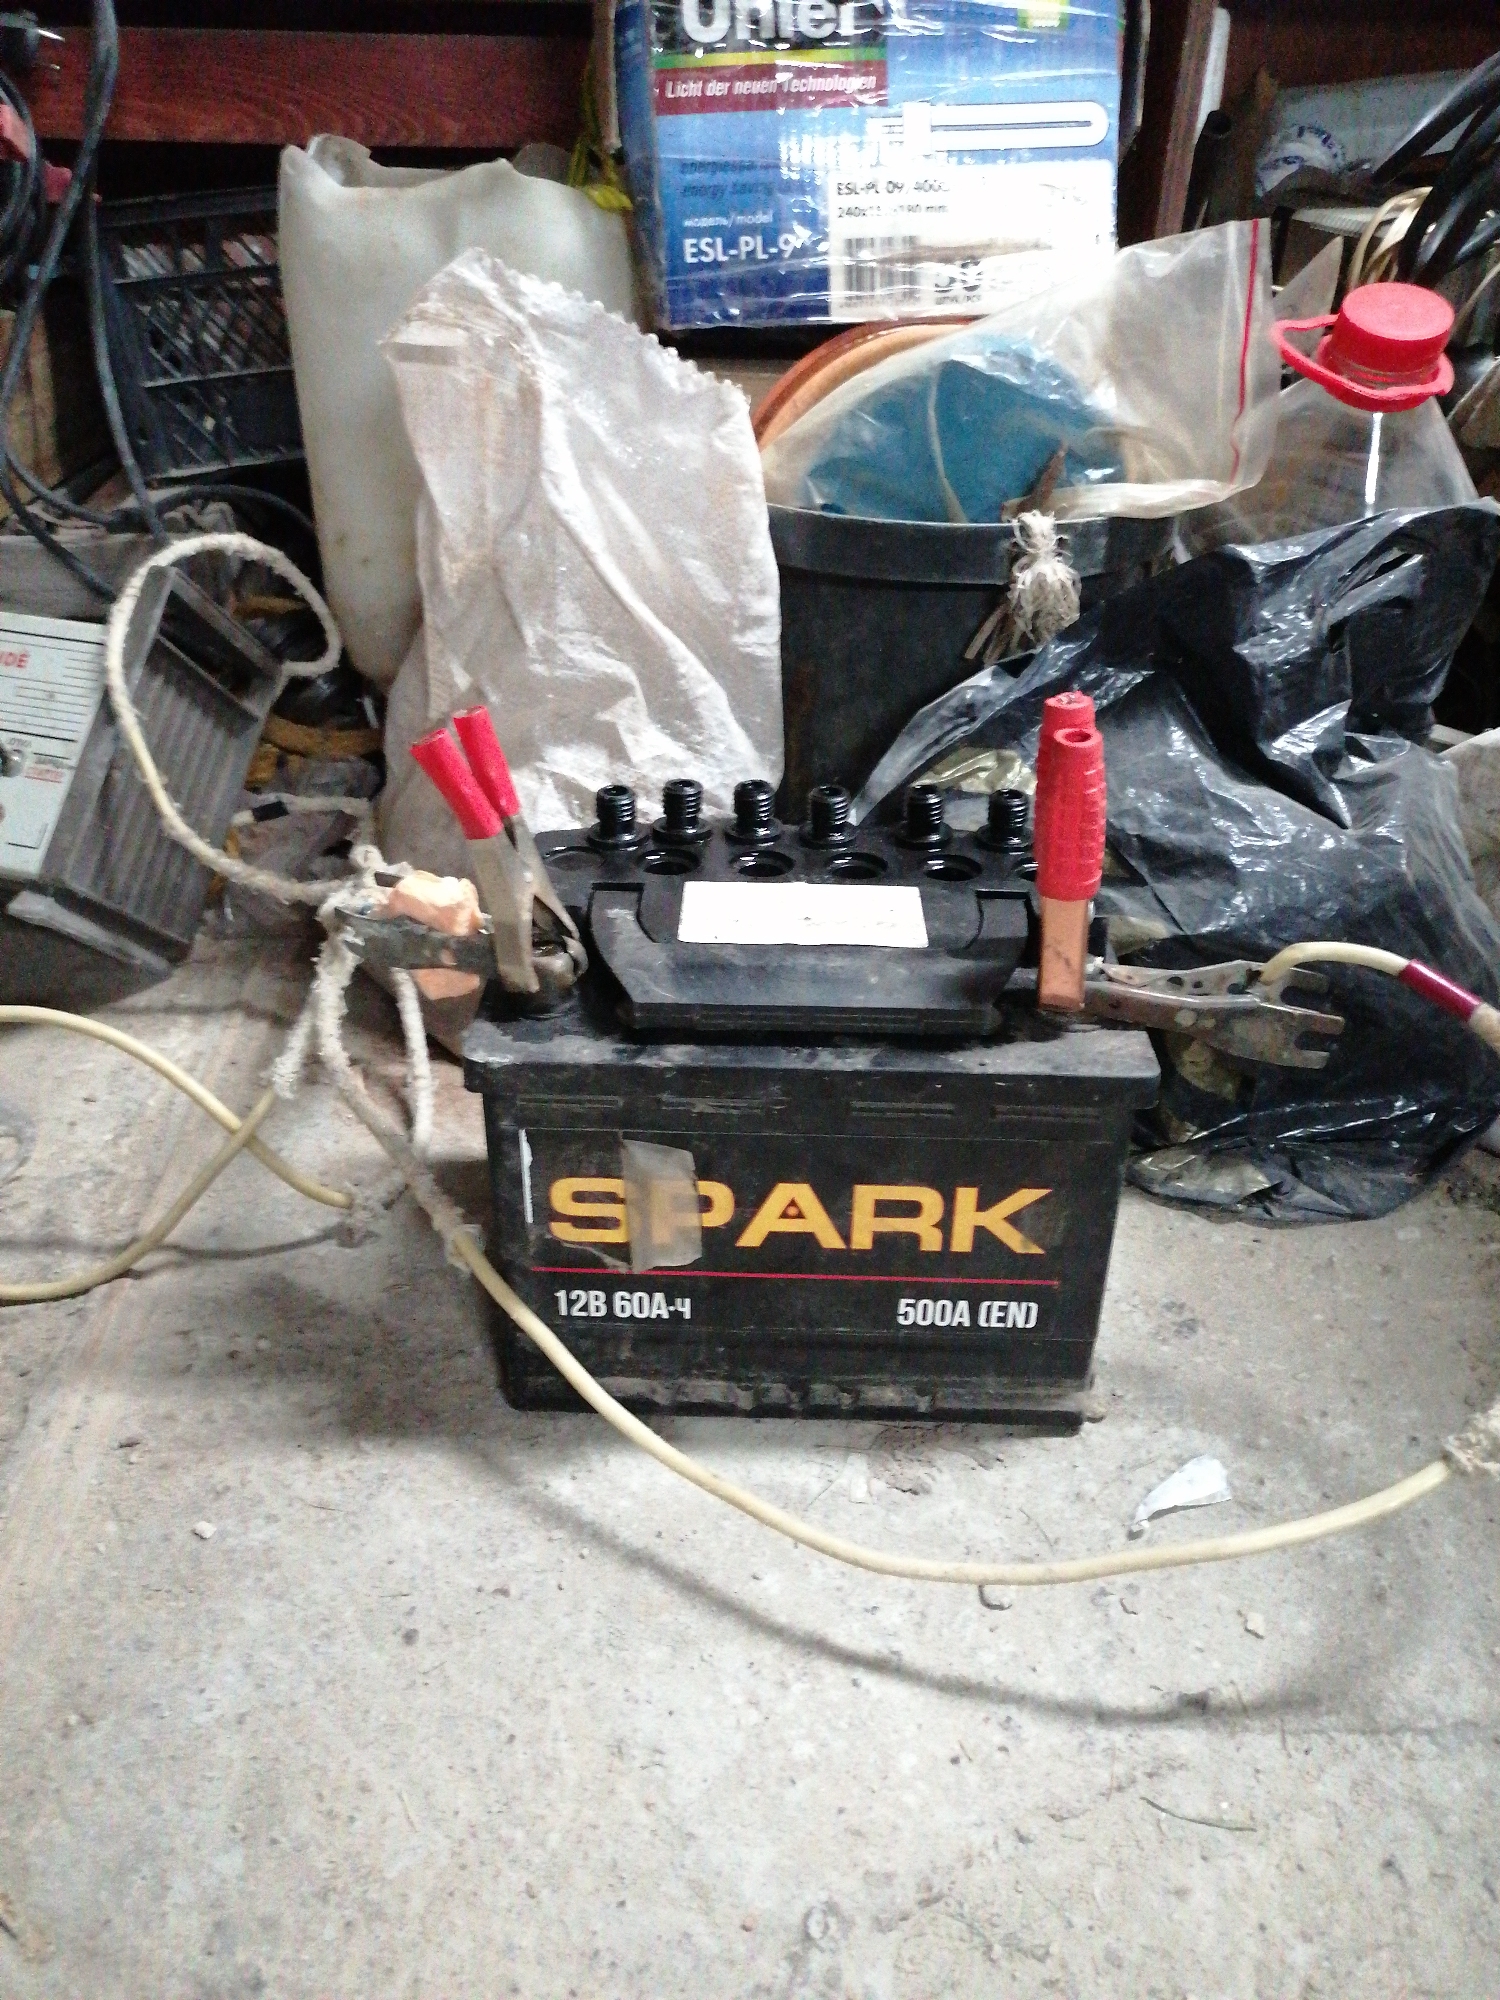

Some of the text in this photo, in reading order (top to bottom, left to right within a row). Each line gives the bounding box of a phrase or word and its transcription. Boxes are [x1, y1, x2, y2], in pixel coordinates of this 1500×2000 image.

[665, 79, 702, 99] Licht
[706, 79, 731, 97] der
[733, 78, 778, 96] neuen
[548, 1176, 1053, 1255] SPARK
[896, 1298, 1039, 1329] 500A (EN)
